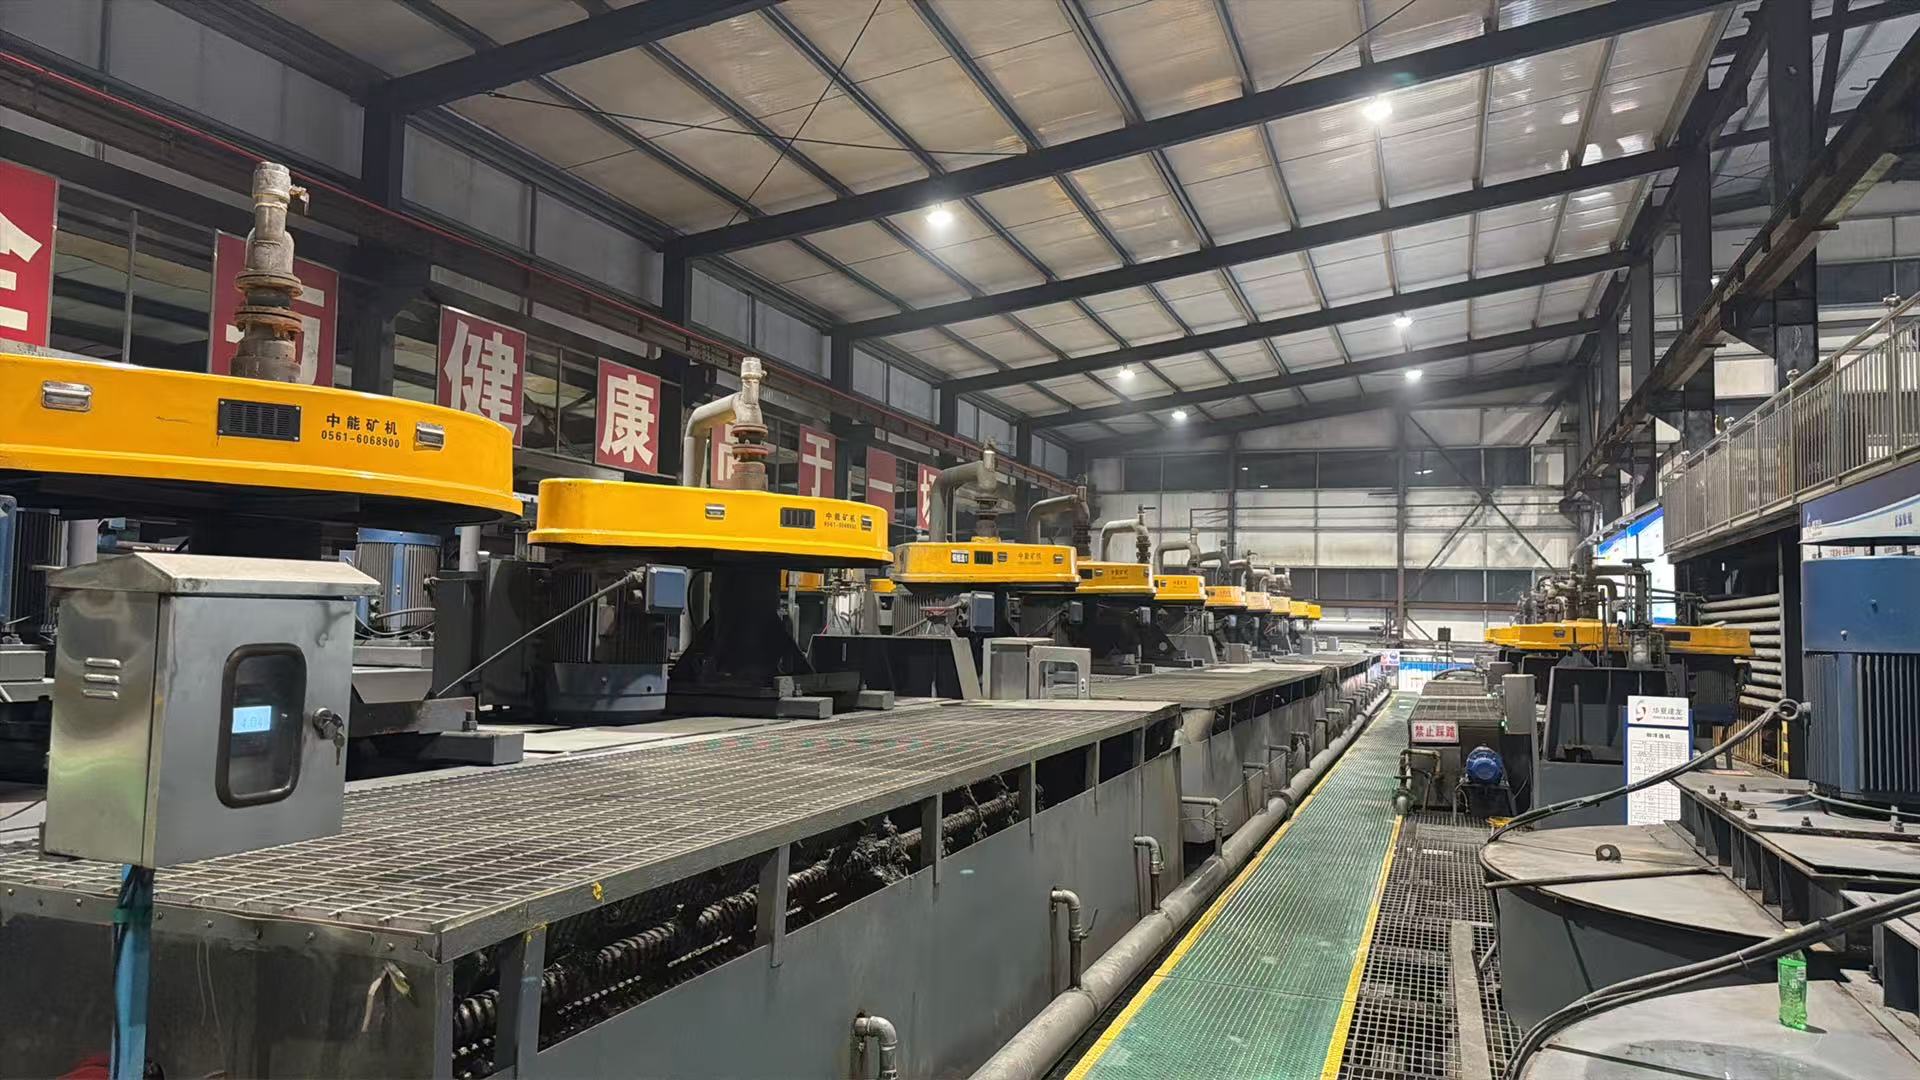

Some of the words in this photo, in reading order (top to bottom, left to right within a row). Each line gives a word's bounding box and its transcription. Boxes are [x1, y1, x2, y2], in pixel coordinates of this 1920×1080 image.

[443, 320, 517, 438] 健
[321, 430, 400, 448] 0561-6068900
[326, 413, 397, 436] 中能矿机
[601, 374, 655, 465] 康
[802, 432, 832, 498] 于
[868, 478, 894, 493] 一
